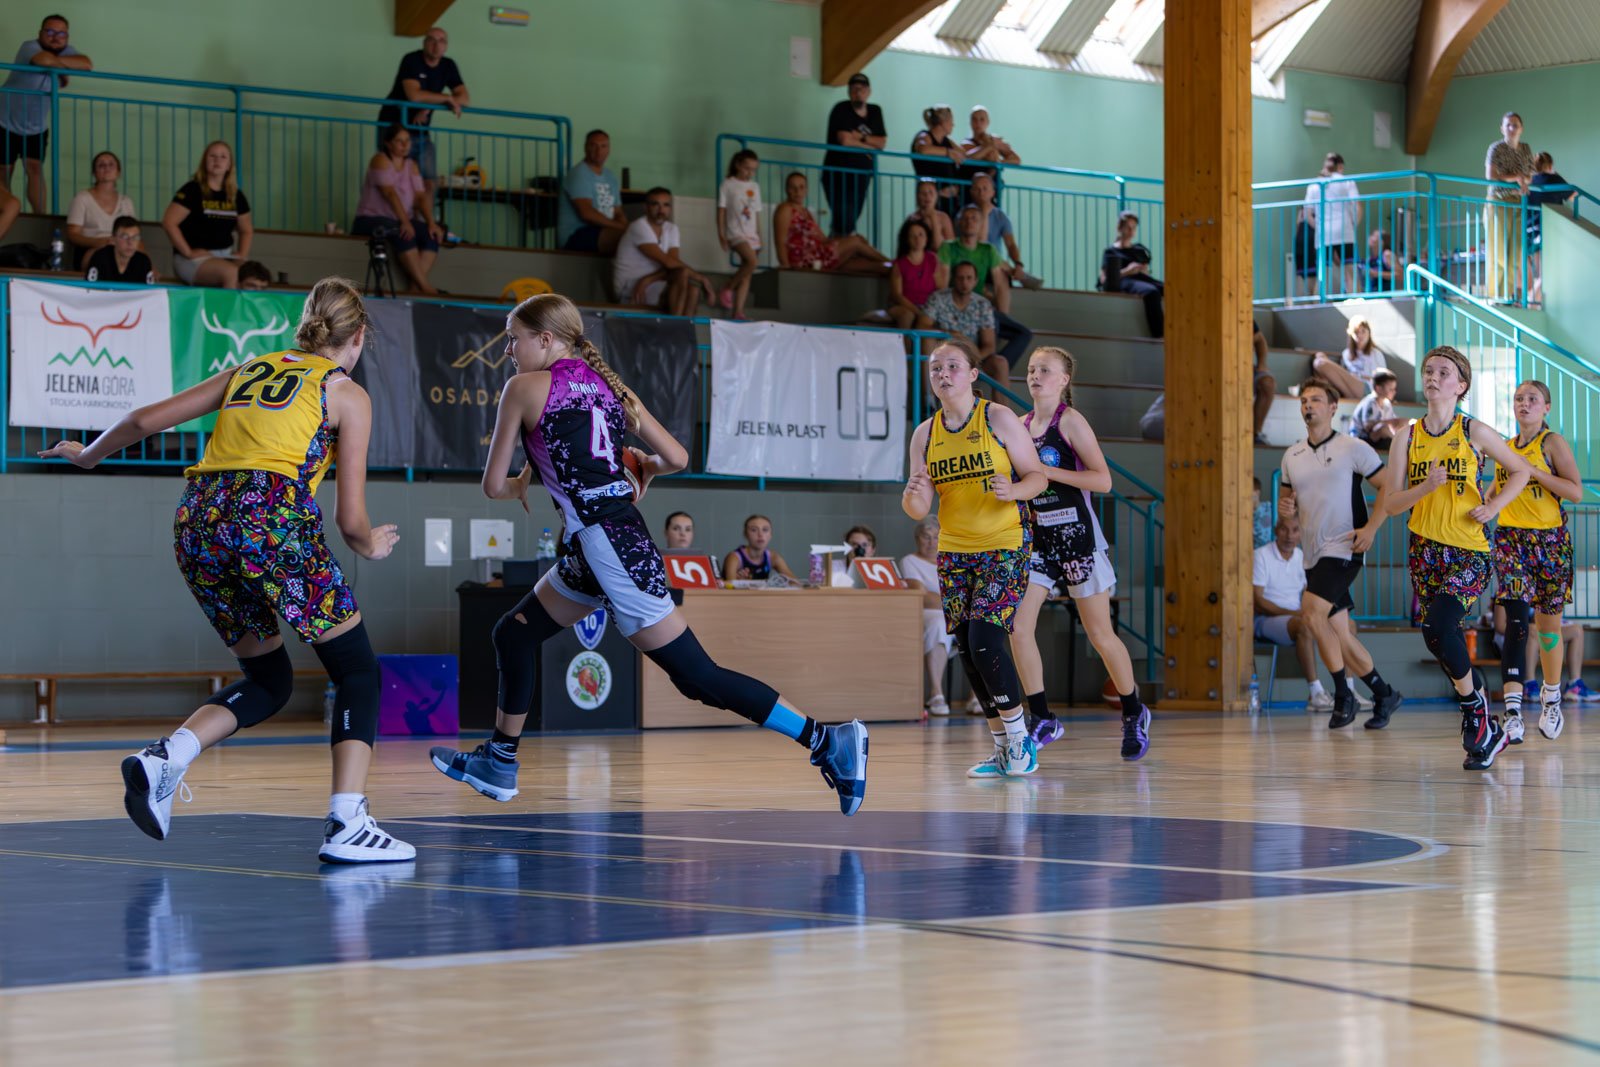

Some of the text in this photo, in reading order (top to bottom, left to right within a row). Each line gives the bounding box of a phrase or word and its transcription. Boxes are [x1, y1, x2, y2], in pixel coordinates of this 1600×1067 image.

[45, 373, 136, 396] JELENIA GÓRA
[225, 361, 313, 410] 25
[49, 397, 132, 410] STOLICA KARKONOSZY
[590, 405, 620, 473] 4
[735, 420, 826, 439] JELENA PLAST
[930, 452, 985, 479] DREAM
[983, 450, 993, 468] TEAM
[1410, 458, 1460, 479] DRAM
[1456, 481, 1465, 496] 3
[1531, 486, 1543, 500] 17
[671, 559, 709, 586] 5
[861, 562, 896, 586] 5
[1062, 559, 1083, 581] 33
[583, 613, 598, 631] 10
